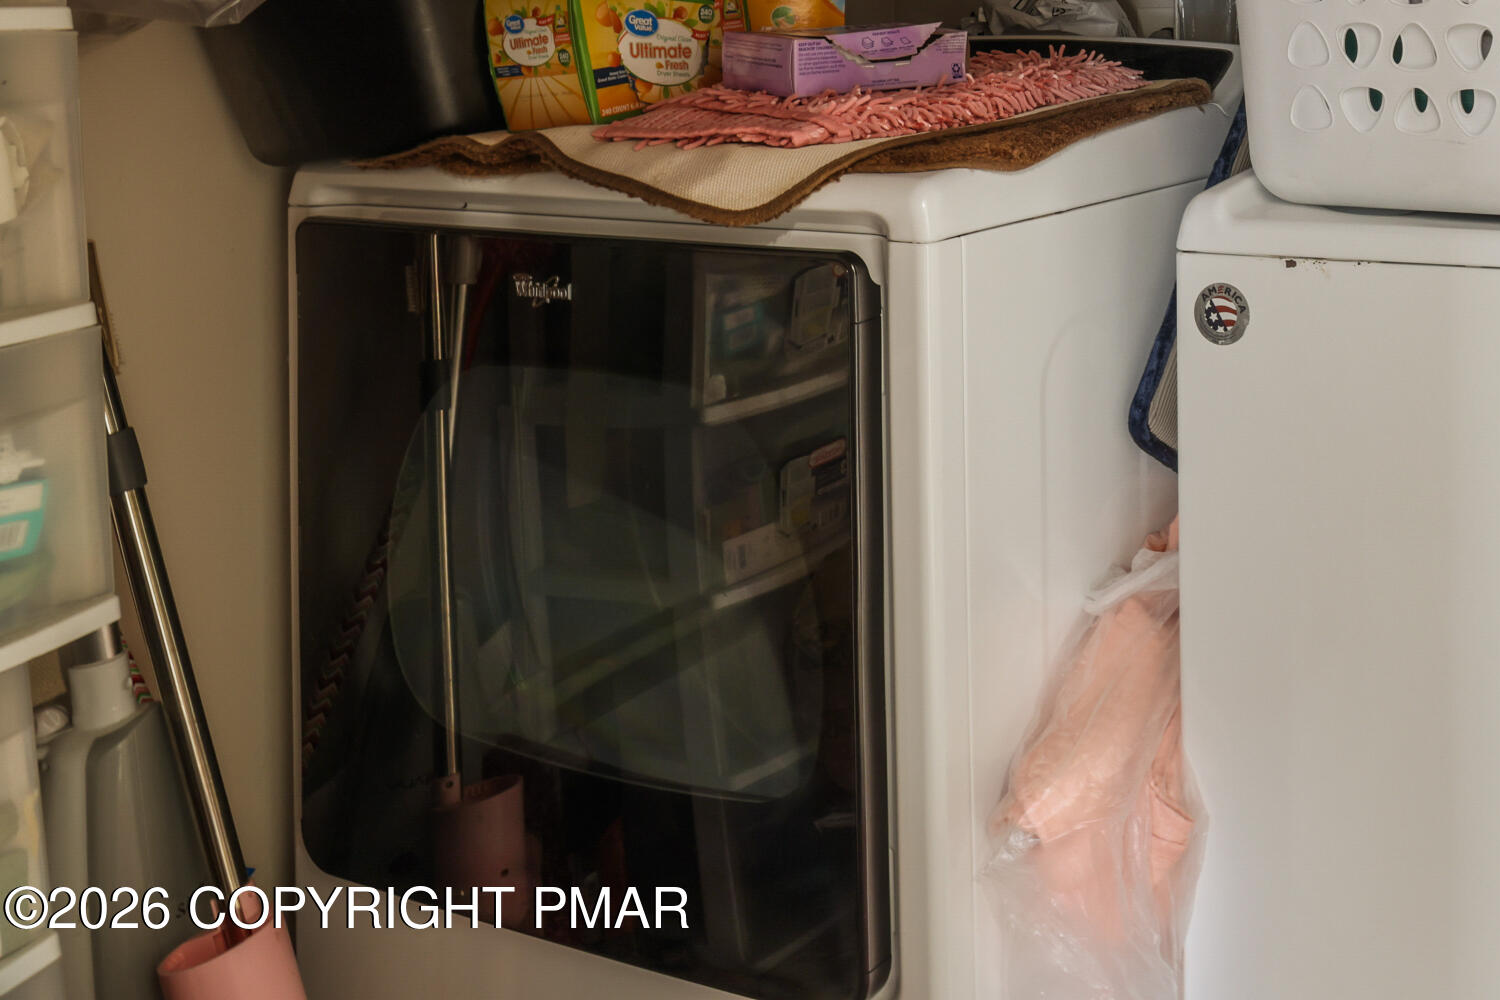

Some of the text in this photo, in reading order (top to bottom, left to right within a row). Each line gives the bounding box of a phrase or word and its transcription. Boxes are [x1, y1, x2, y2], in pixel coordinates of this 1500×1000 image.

[628, 14, 654, 26] Great
[629, 42, 693, 60] Ultimate
[665, 60, 689, 71] Fresh
[514, 279, 573, 304] Whirlpool
[1201, 285, 1247, 314] AMERICA
